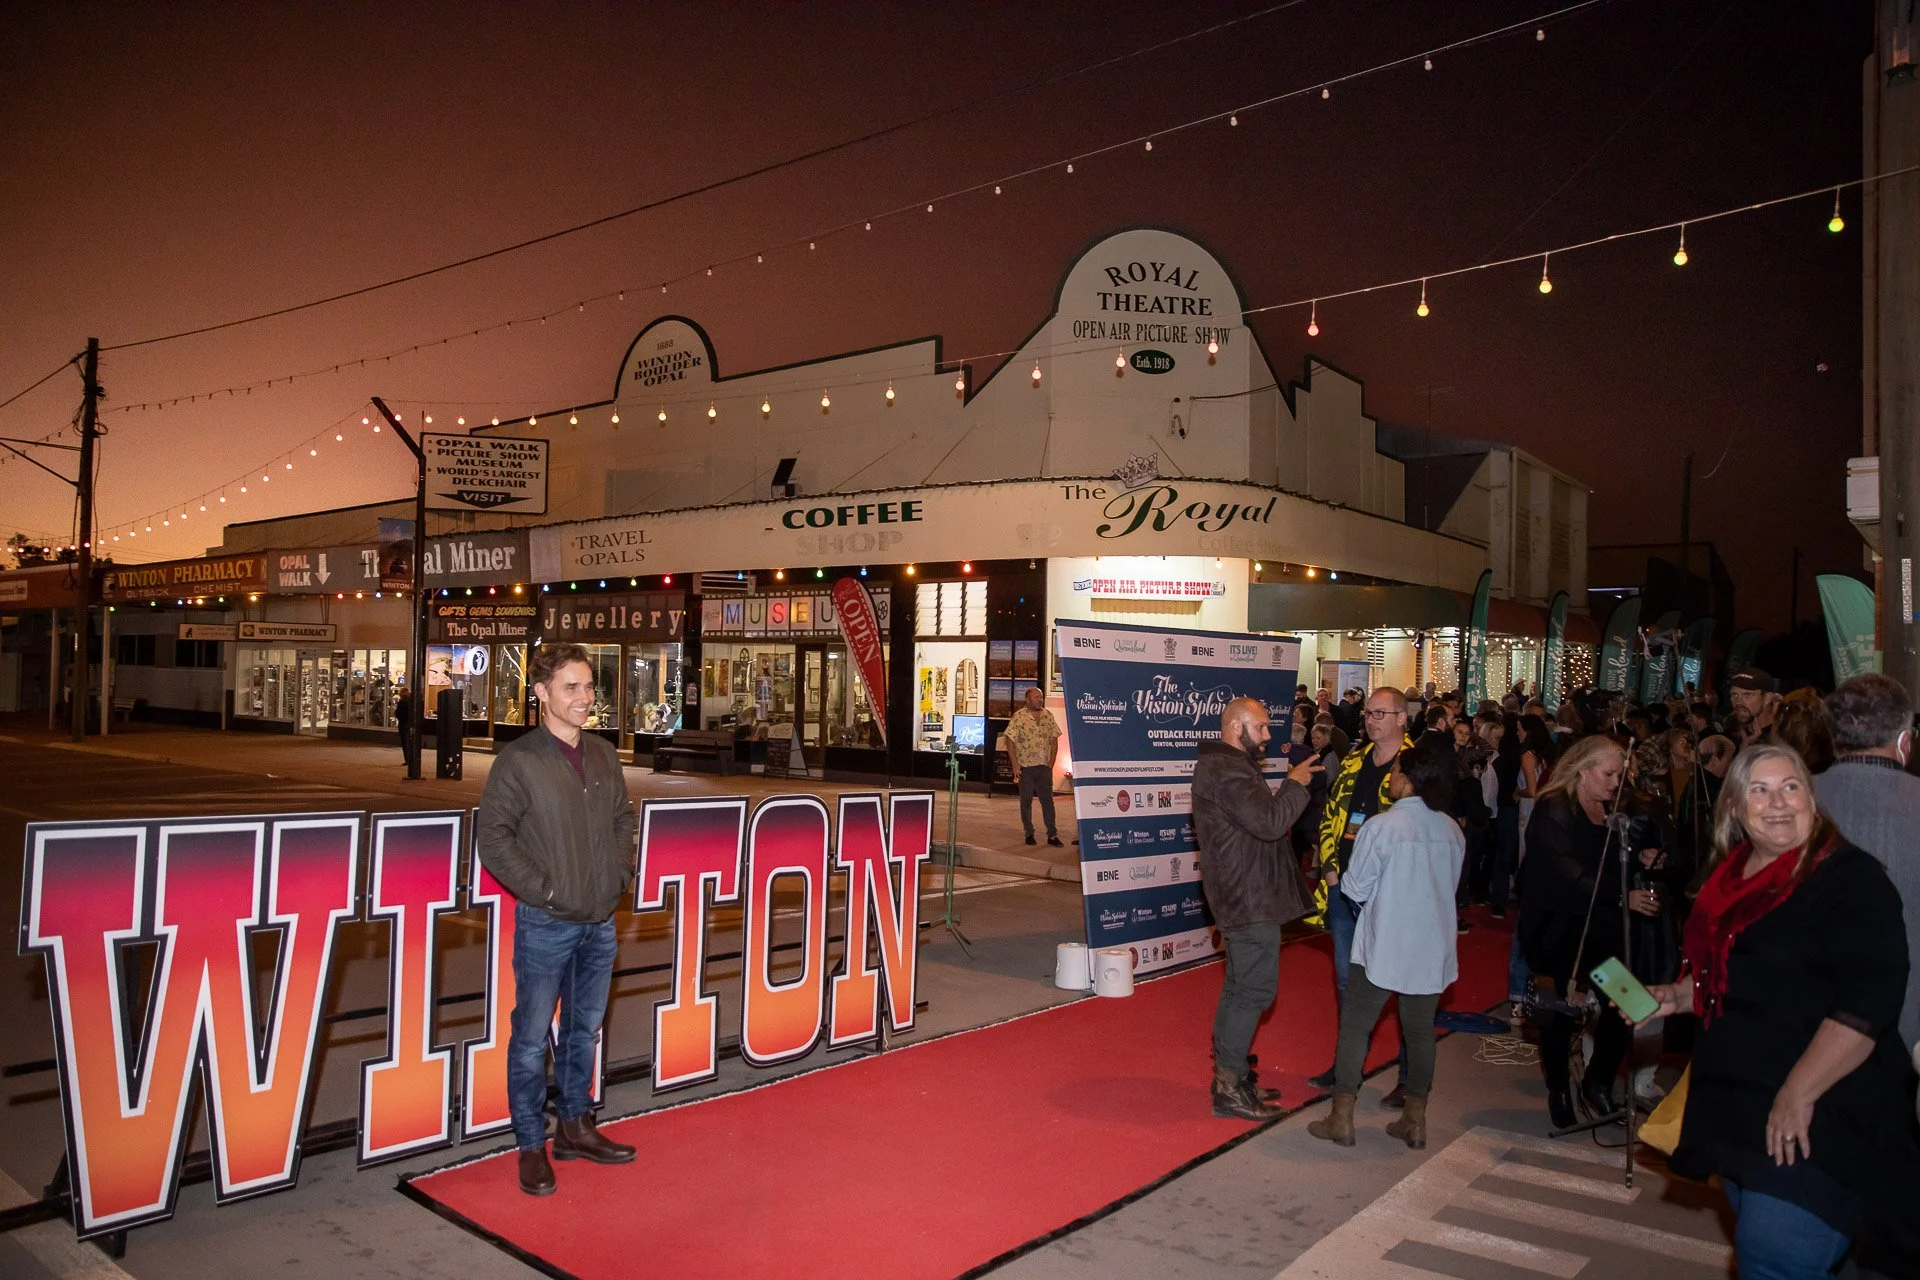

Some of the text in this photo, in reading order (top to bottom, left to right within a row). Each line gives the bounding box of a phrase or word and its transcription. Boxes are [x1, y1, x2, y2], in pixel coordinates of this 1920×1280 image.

[1104, 262, 1200, 291] ROYAL
[1097, 292, 1212, 316] THEATRE
[1073, 320, 1231, 346] OPEN AIR PICTURE SHOW
[637, 350, 692, 369] WINTON
[1136, 356, 1170, 369] Estb. 1918
[634, 357, 701, 380] BOULDER
[644, 371, 687, 387] OPAL
[436, 439, 539, 452] OPAL WALK
[437, 448, 540, 461] PICTURE SHOW
[456, 458, 523, 469] MUSEUM
[437, 467, 540, 480] WORLD'S LARGEST
[452, 477, 527, 488] DECKCHAIR
[462, 492, 505, 503] VISIT
[782, 500, 923, 530] COFFEE
[1060, 484, 1277, 539] The Royal
[575, 530, 653, 550] TRAVEL
[795, 530, 903, 556] SHOP
[280, 555, 310, 570] OPAL
[361, 550, 380, 578] Th
[450, 540, 515, 573] Miner
[580, 549, 645, 568] OPALS
[118, 559, 255, 588] WINTON PHARMACY
[279, 571, 312, 587] WALK
[193, 582, 241, 595] CHEMIST
[382, 581, 410, 590] WINTON
[1092, 579, 1116, 593] OPEN
[1119, 580, 1137, 594] AIR
[1140, 580, 1181, 595] PICTURE
[1184, 581, 1212, 596] SHOW
[439, 606, 537, 617] GIFTS GEMS SOUVENIRS
[726, 602, 834, 625] MUSEU
[544, 606, 682, 636] Jewellery
[258, 627, 328, 637] WINTON PHARMACY
[447, 622, 527, 639] The Opal Miner
[844, 599, 879, 664] OPEN
[1082, 638, 1101, 649] BNE
[1198, 646, 1215, 657] BNE
[1229, 644, 1258, 655] IT'S LIVE!
[1466, 627, 1480, 685] LIVE!
[1153, 674, 1178, 697] The
[1077, 699, 1098, 710] Vision
[1084, 692, 1095, 702] The
[1133, 690, 1184, 715] Vision
[1148, 730, 1221, 739] OUTBACK FILM FESTI
[1158, 797, 1172, 808] INK
[1103, 870, 1119, 881] BNE
